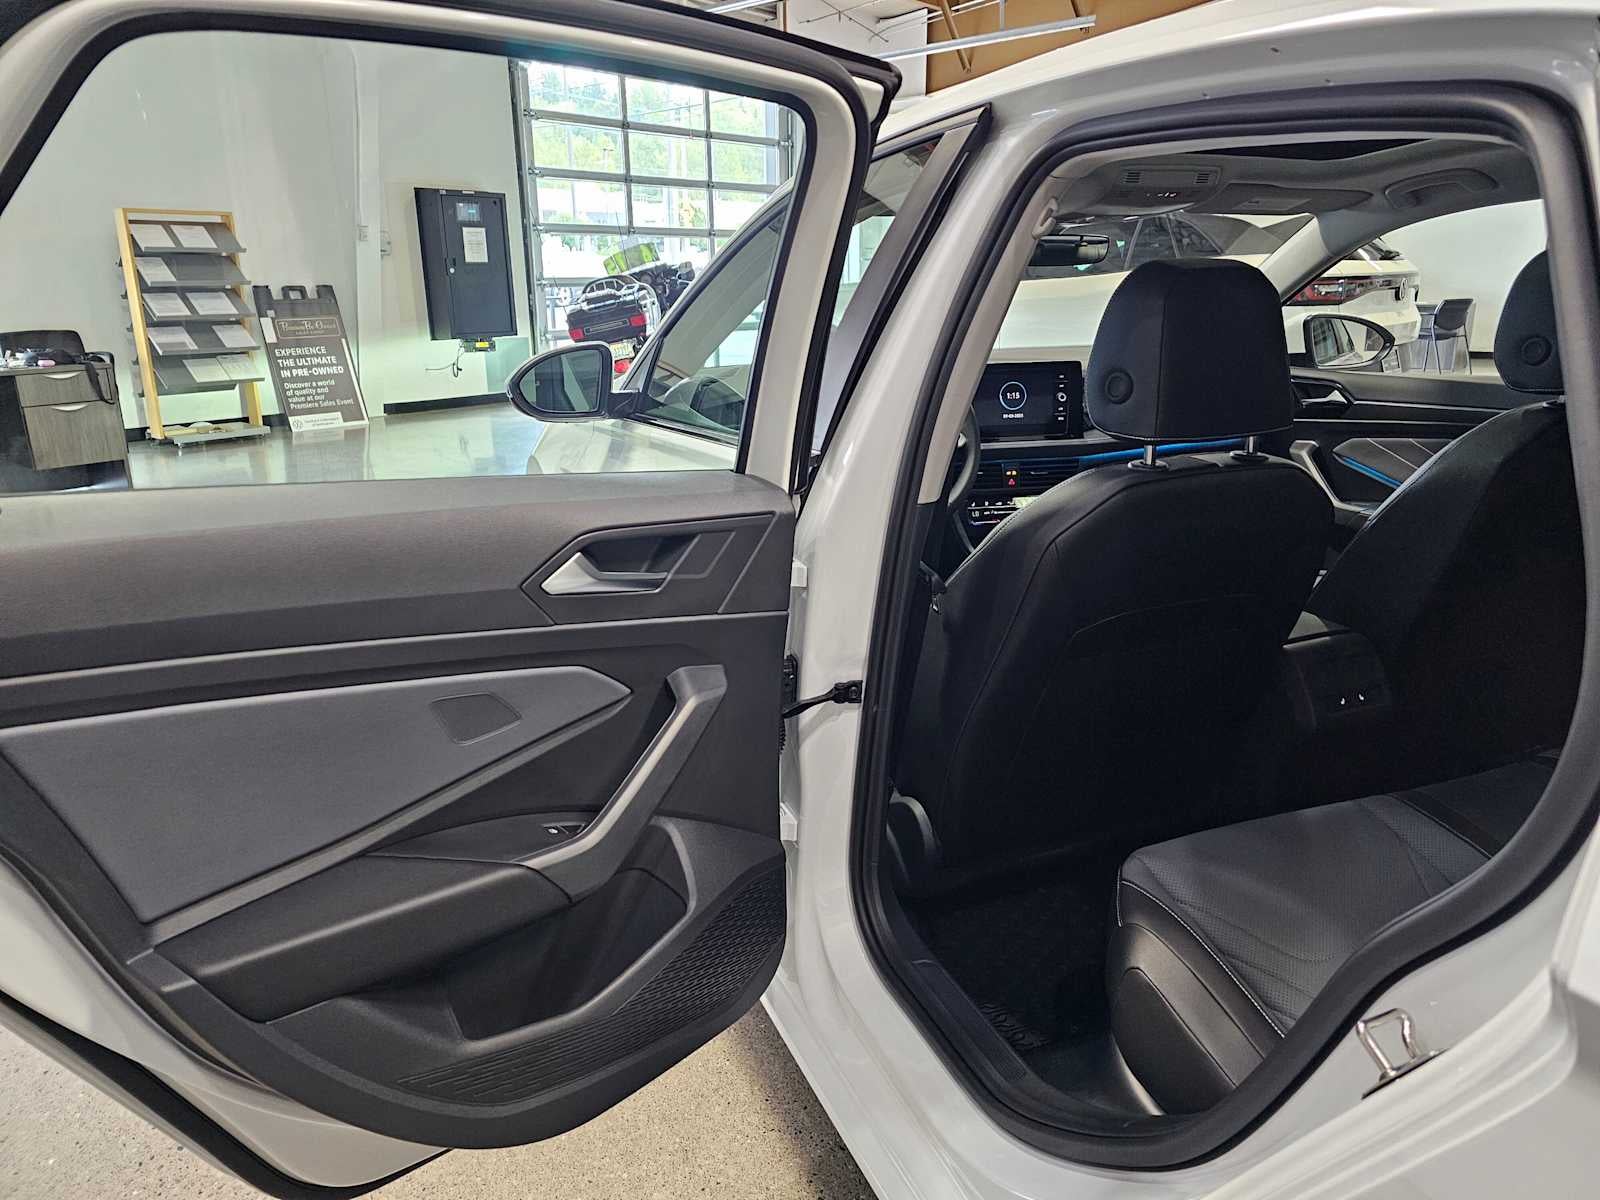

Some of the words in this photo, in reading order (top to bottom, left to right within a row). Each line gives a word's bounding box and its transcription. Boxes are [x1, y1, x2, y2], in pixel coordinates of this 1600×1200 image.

[275, 346, 327, 357] EXPERIENCE
[277, 358, 296, 367] THE
[296, 356, 337, 366] ULTIMATE
[281, 369, 291, 378] IN
[292, 366, 344, 377] PRE-OWNED
[284, 381, 311, 389] Discover
[317, 379, 335, 387] world
[294, 387, 316, 396] quality
[1006, 391, 1020, 399] 1:15
[288, 395, 306, 403] value
[290, 401, 319, 410] Premiere
[336, 398, 354, 406] Event
